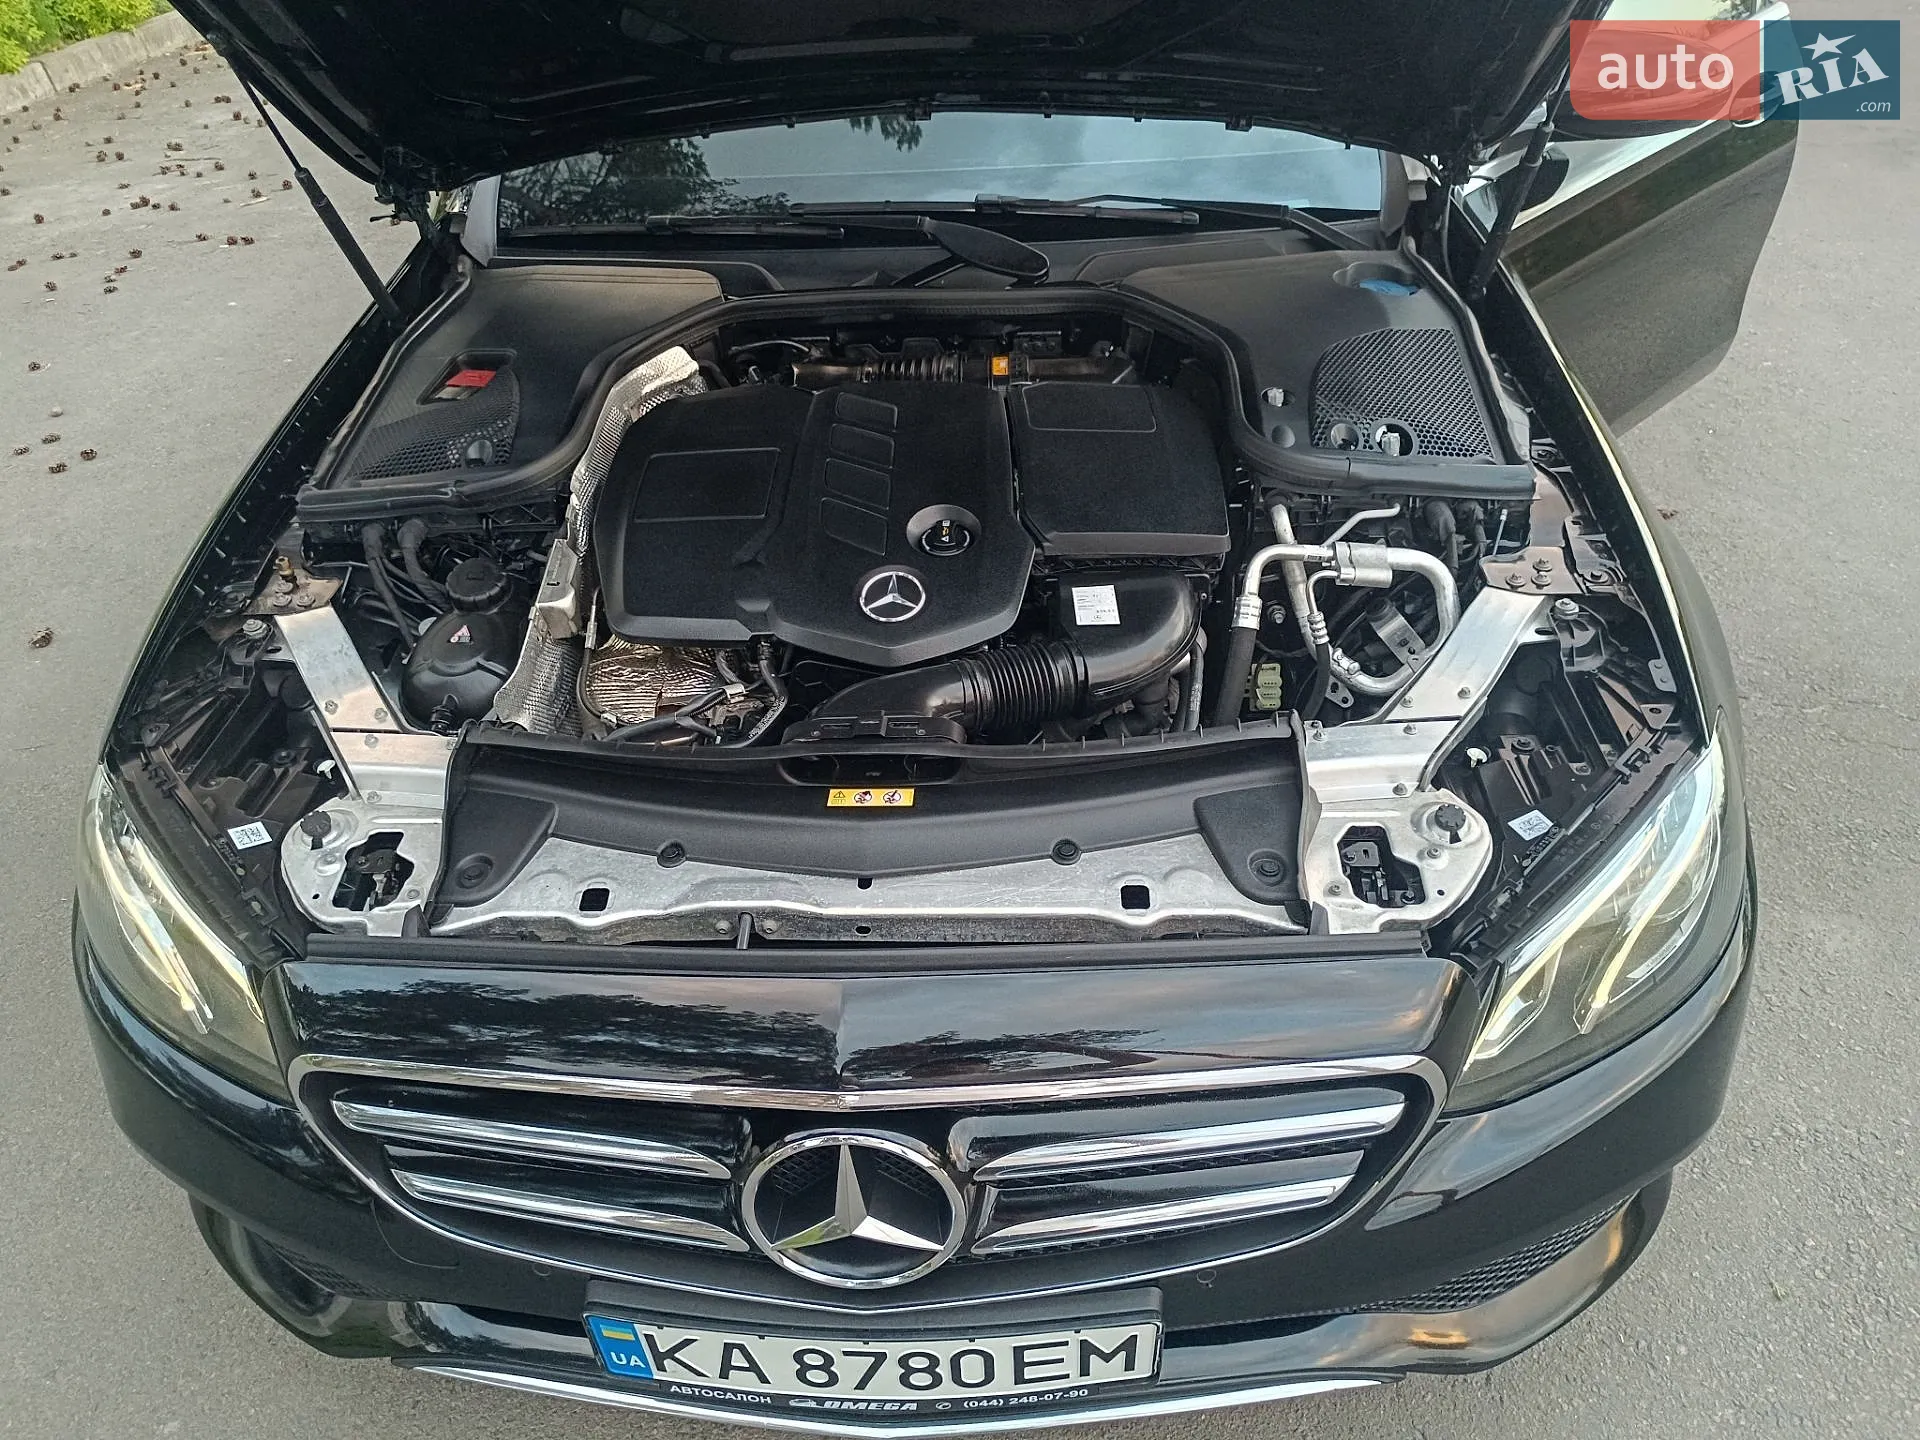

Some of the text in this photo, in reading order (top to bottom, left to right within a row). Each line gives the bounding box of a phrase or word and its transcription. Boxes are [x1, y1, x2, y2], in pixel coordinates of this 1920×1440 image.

[610, 1351, 646, 1368] UA
[643, 1332, 772, 1385] KA
[670, 1385, 772, 1404] АВТОСАЛОН
[822, 1400, 918, 1411] OMEGA
[963, 1398, 1004, 1409] (044)
